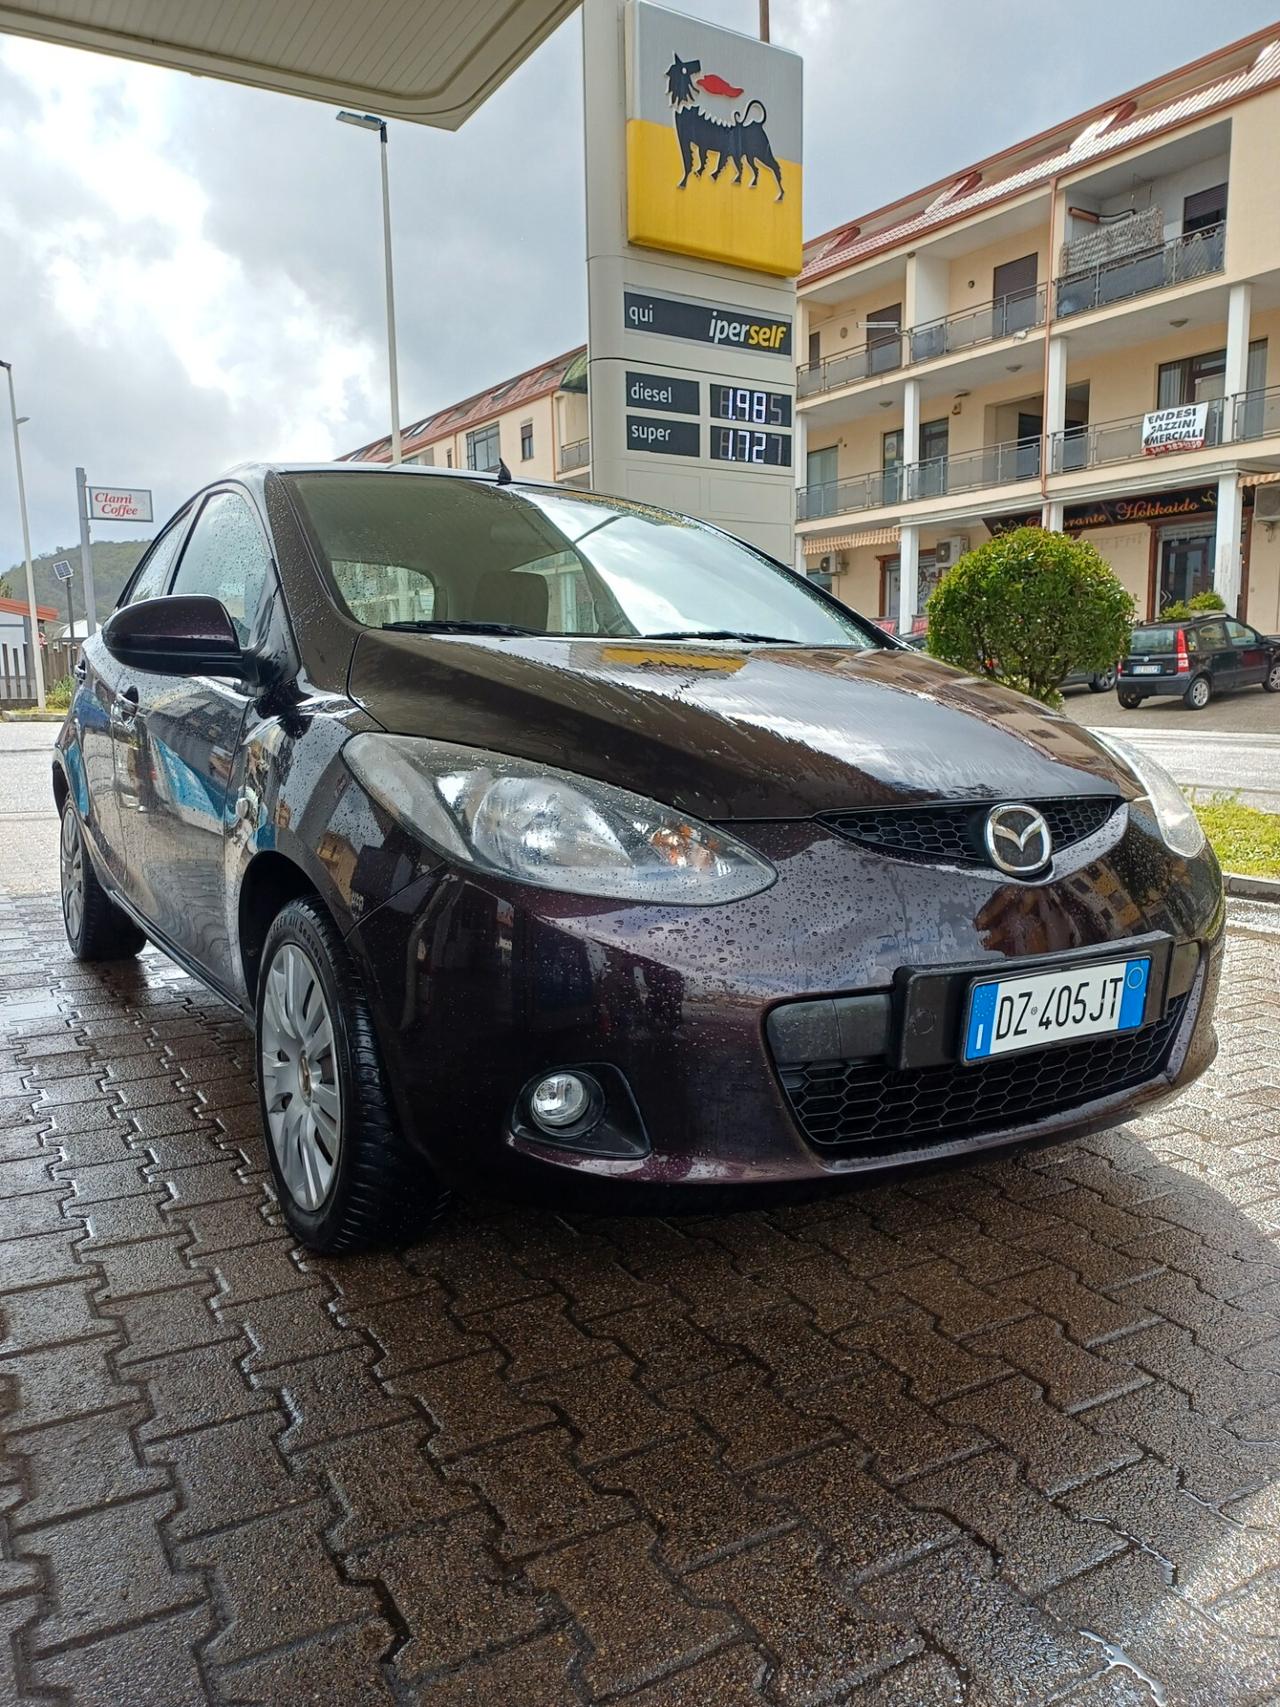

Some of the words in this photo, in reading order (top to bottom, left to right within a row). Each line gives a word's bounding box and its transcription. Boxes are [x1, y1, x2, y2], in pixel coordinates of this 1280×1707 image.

[629, 304, 653, 325] qui
[708, 311, 787, 348] iperself
[630, 382, 672, 404] diesel
[1147, 407, 1197, 425] ENDESI
[631, 423, 671, 444] super
[1146, 429, 1204, 445] MERCIALI
[101, 503, 138, 517] Coffee
[1116, 498, 1200, 520] Hokkaido
